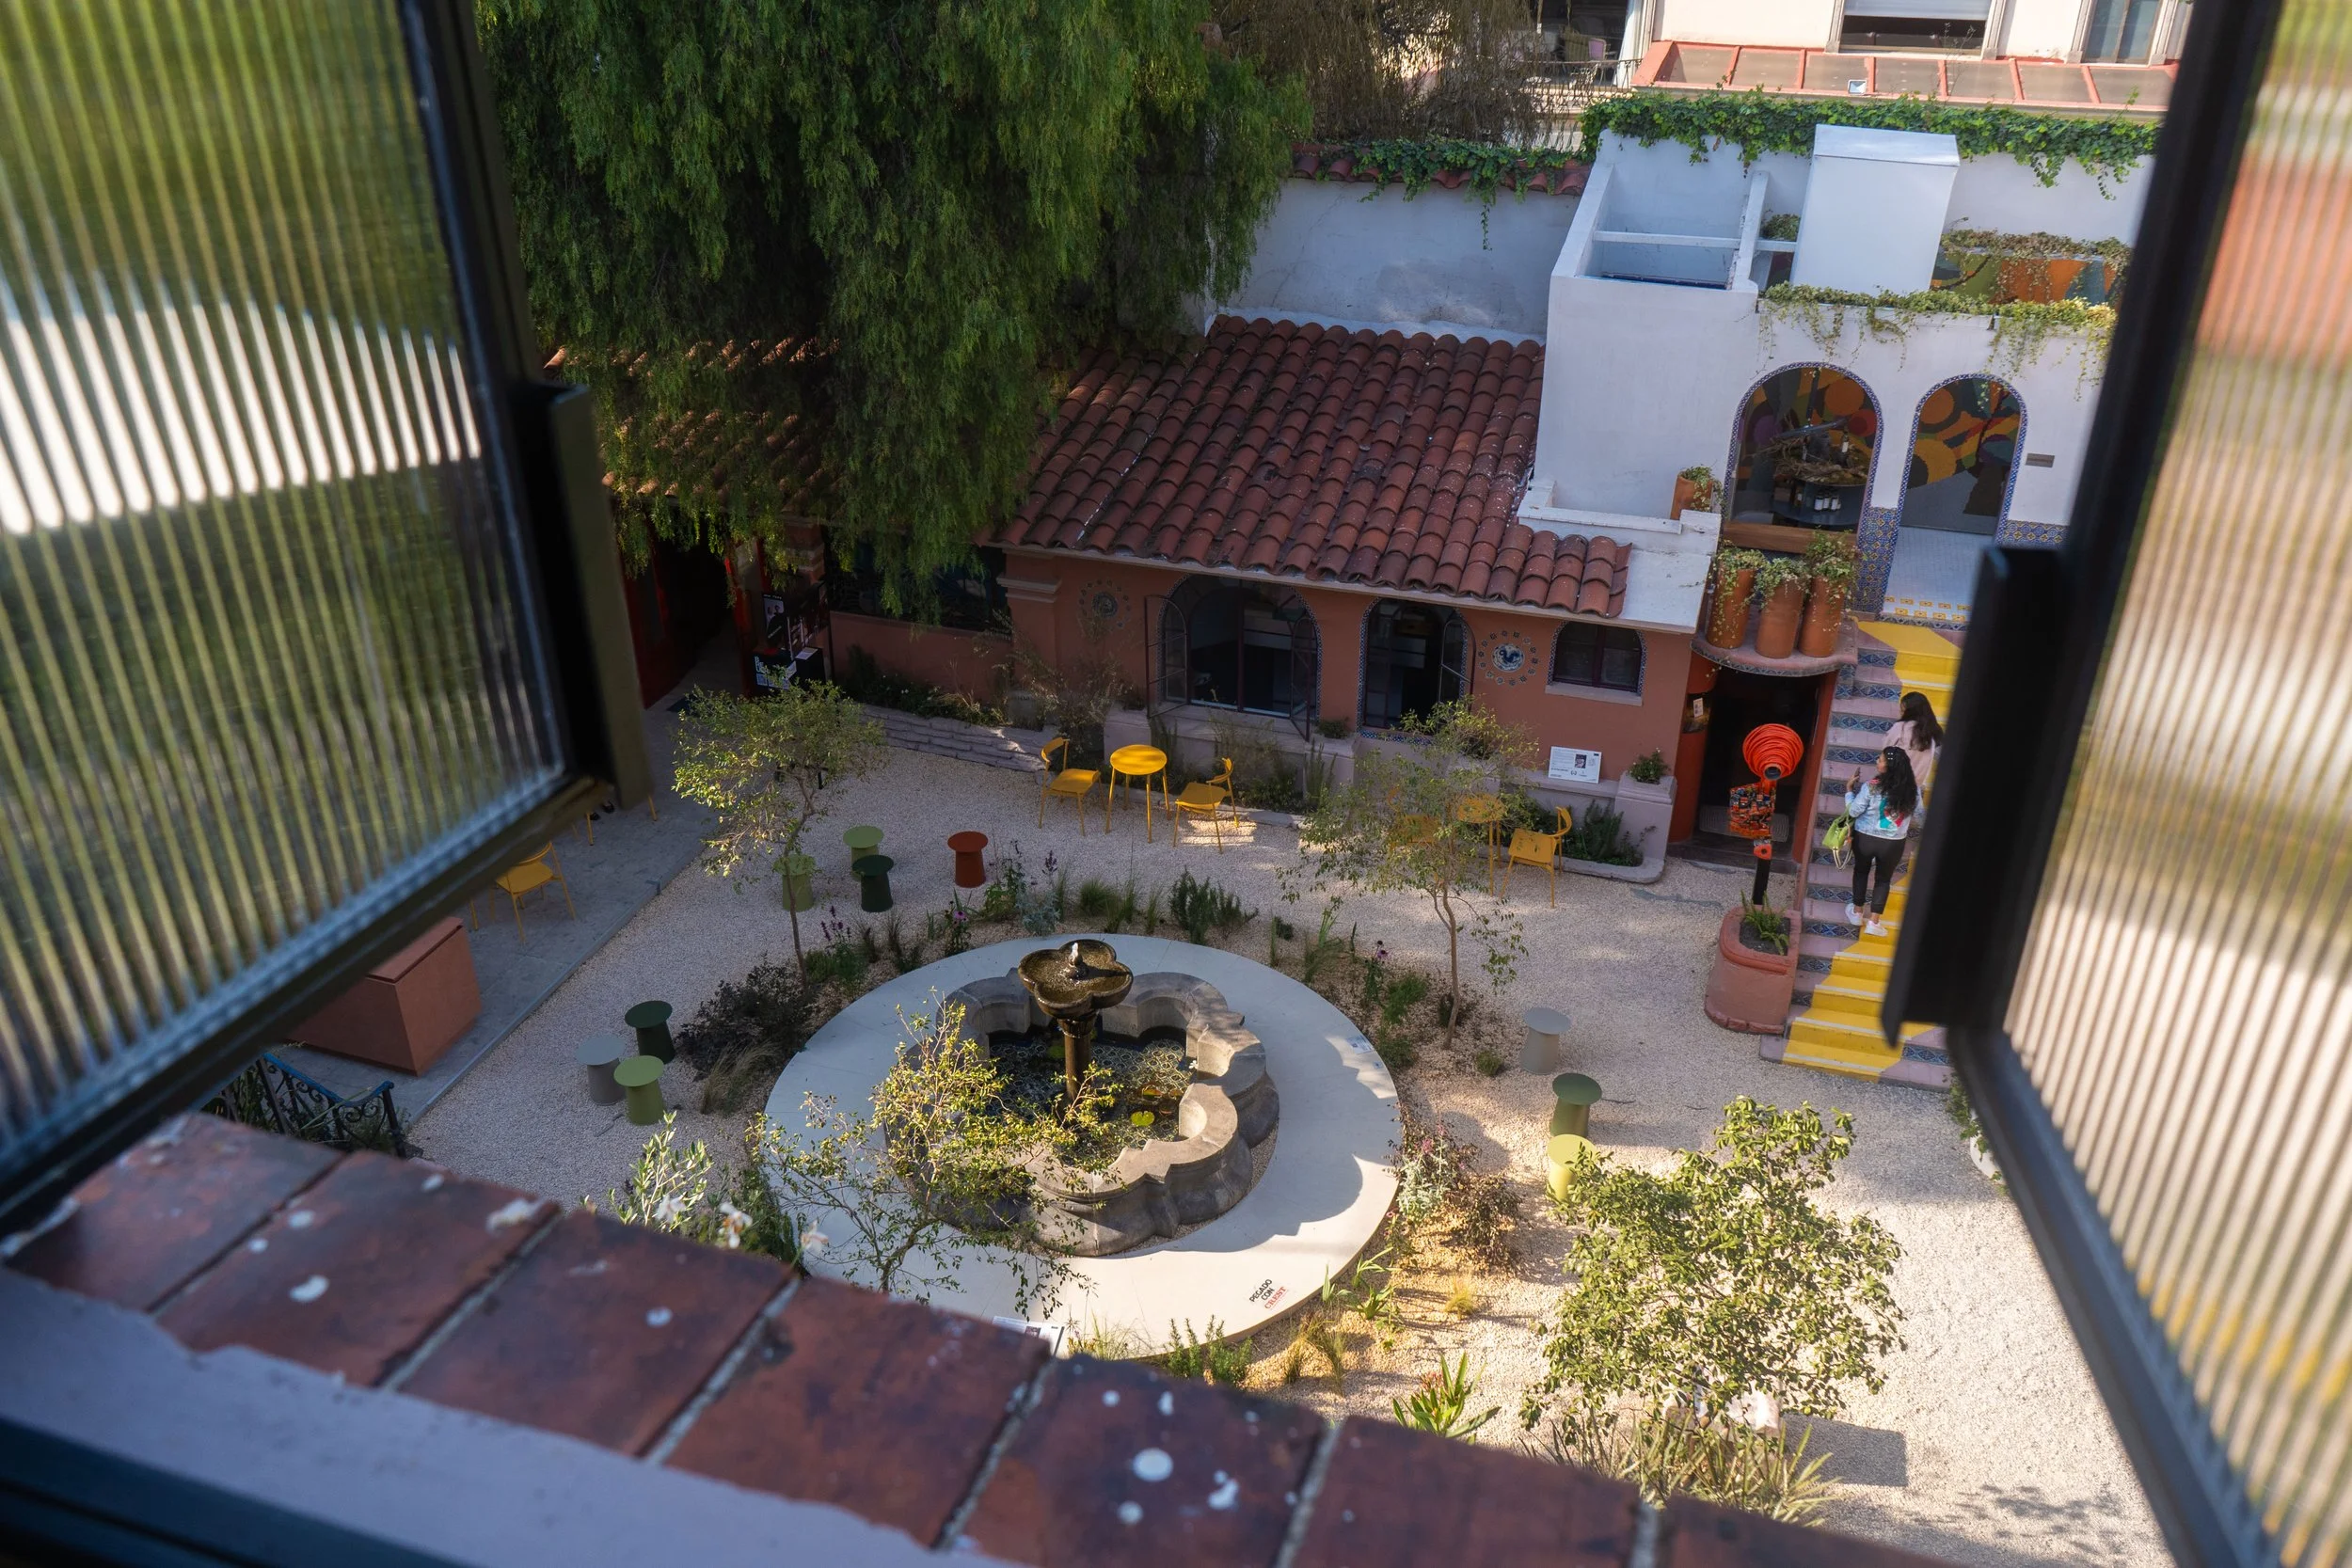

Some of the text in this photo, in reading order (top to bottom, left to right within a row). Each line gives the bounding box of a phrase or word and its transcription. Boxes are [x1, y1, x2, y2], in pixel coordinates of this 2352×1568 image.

[1249, 1279, 1272, 1302] PEGADO
[1261, 1288, 1275, 1301] CON
[1264, 1286, 1286, 1308] CREST
